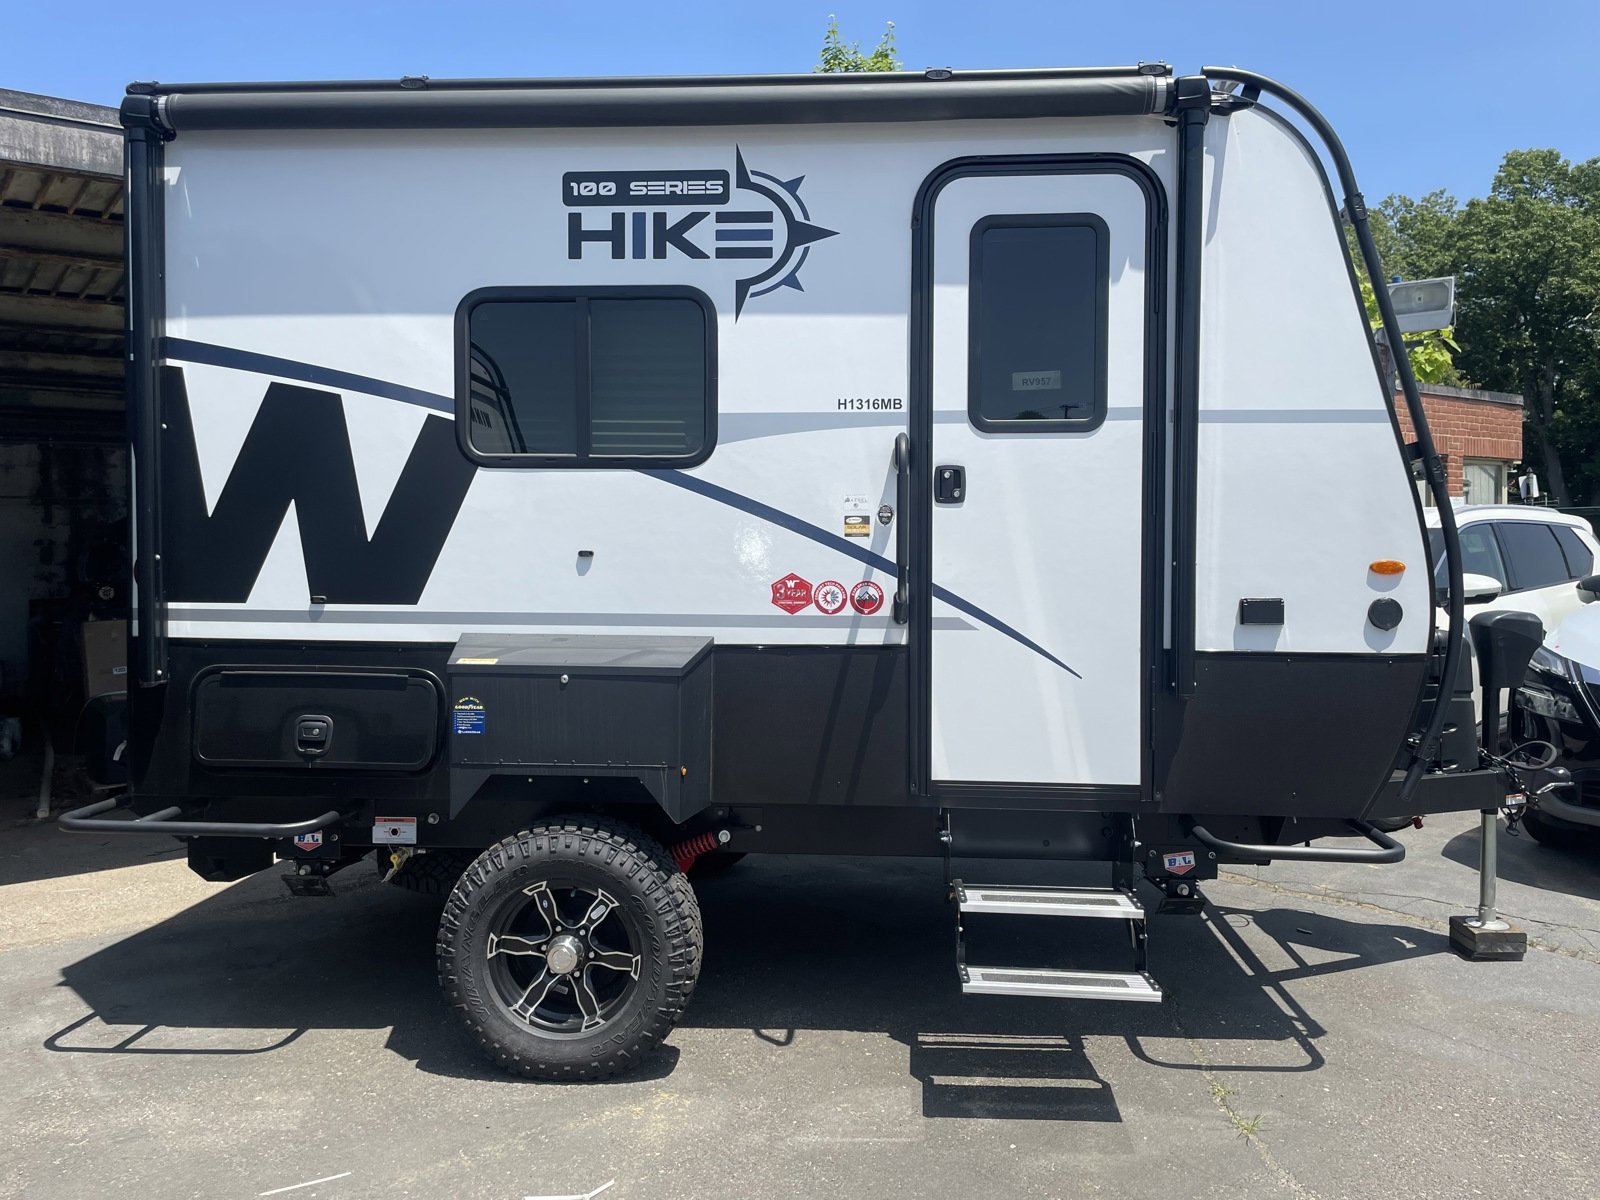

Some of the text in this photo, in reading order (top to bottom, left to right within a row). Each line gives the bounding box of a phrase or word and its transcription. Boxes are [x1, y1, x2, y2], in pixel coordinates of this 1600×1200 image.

[570, 180, 724, 196] 100 SERIES
[568, 211, 774, 260] HIKE
[837, 398, 903, 410] H1316MB
